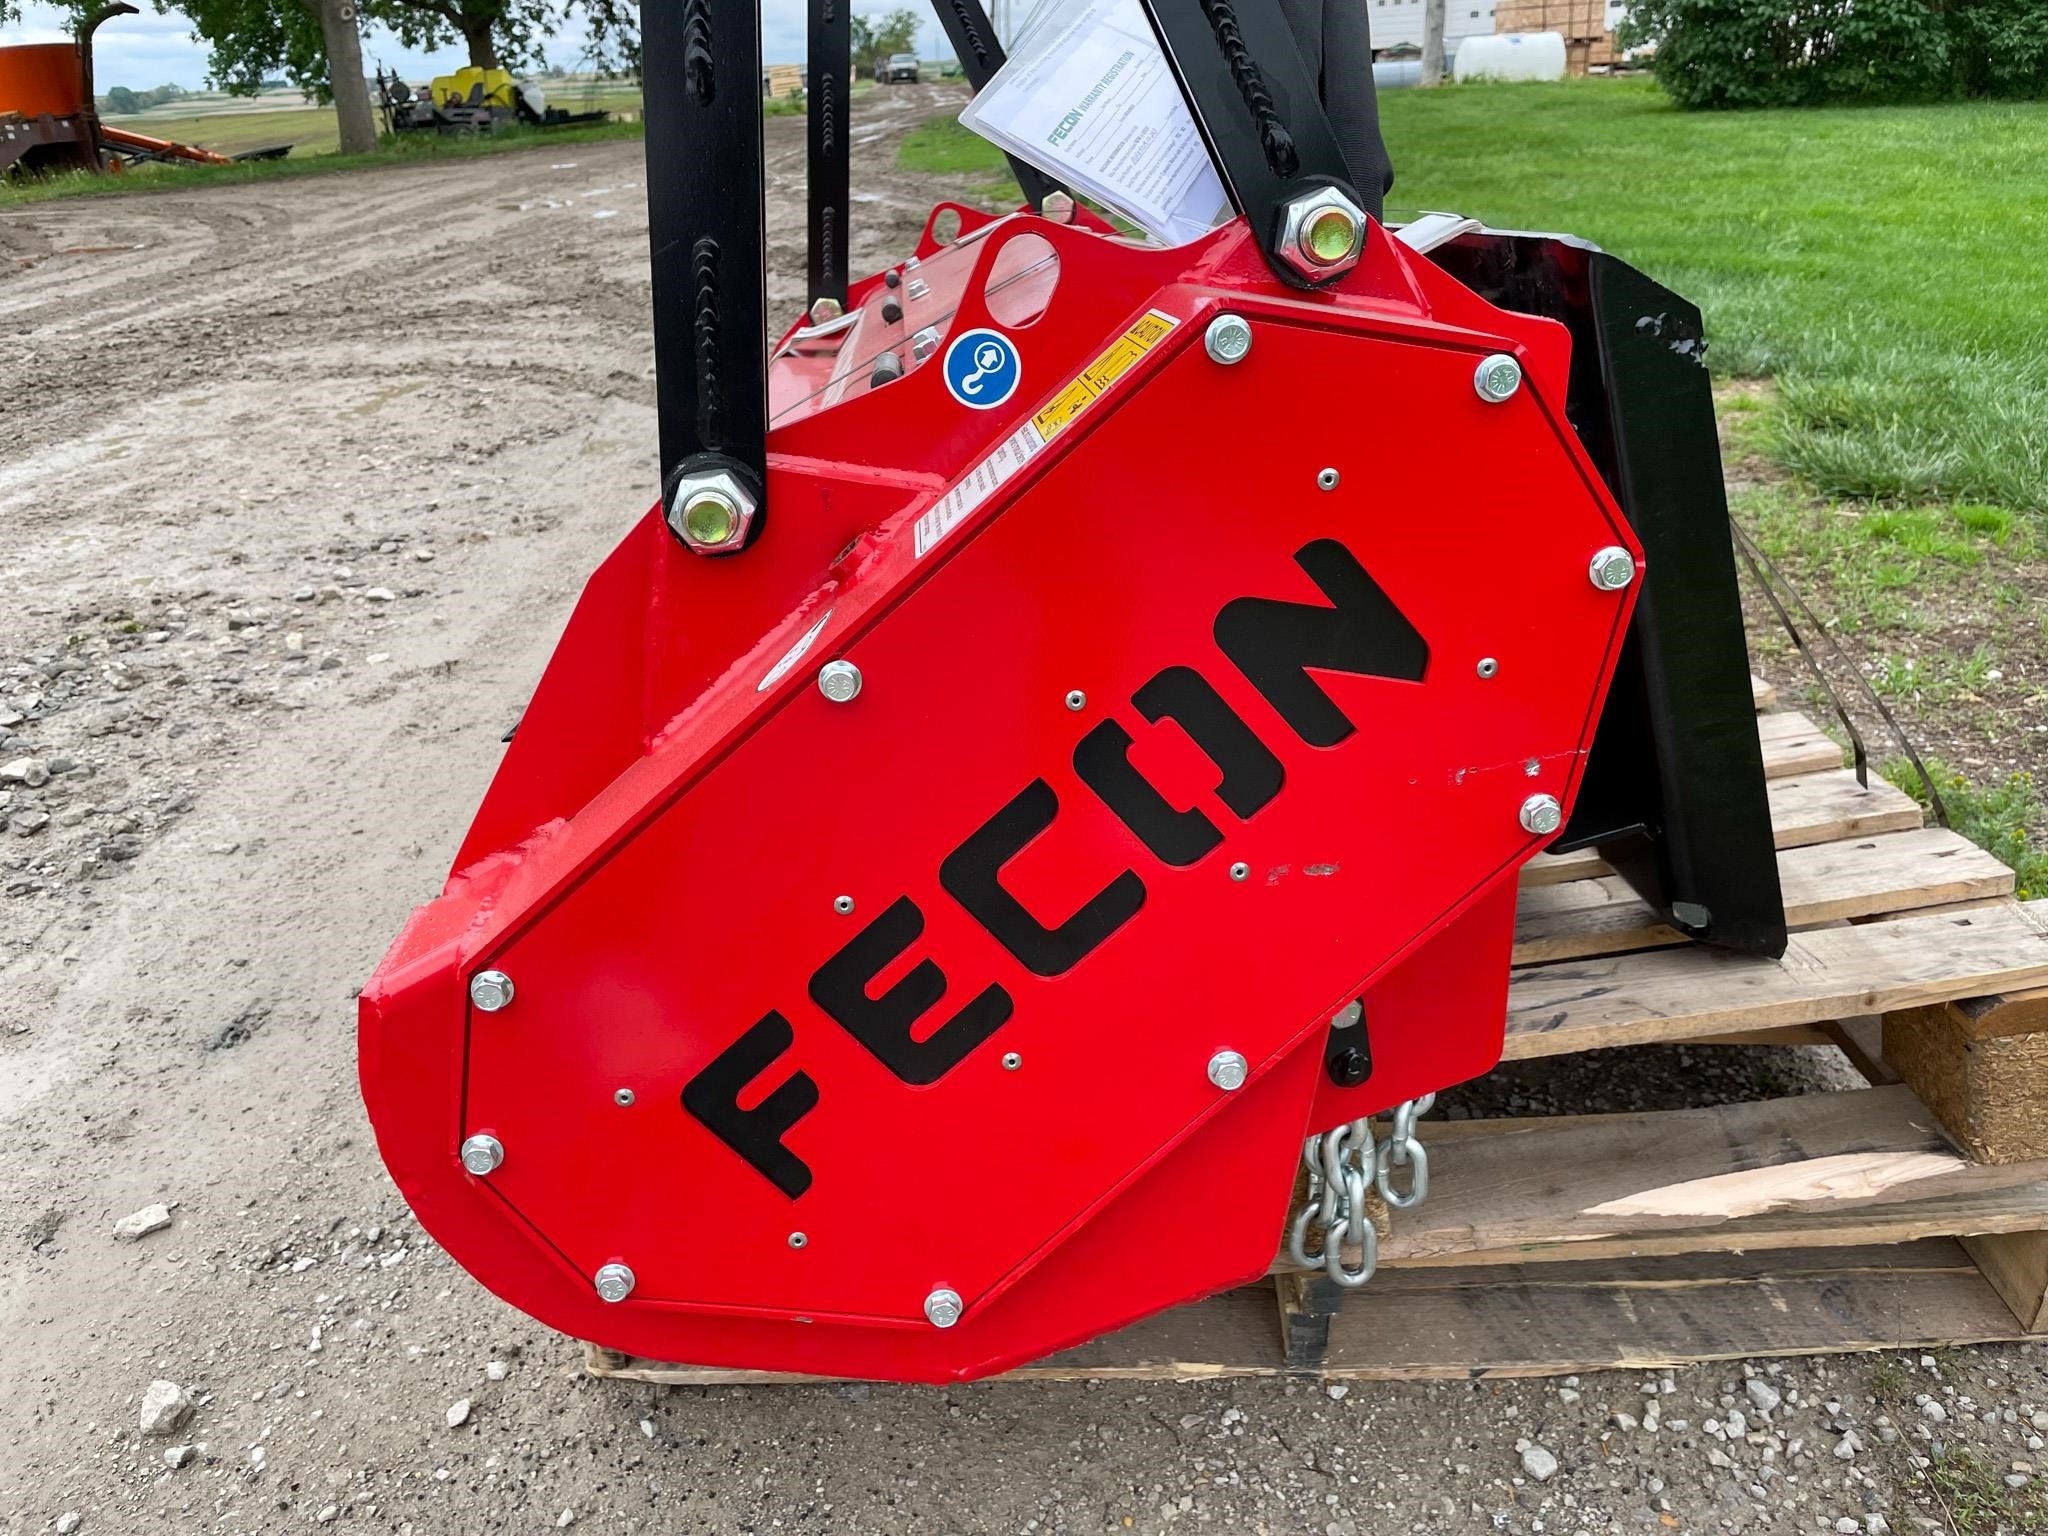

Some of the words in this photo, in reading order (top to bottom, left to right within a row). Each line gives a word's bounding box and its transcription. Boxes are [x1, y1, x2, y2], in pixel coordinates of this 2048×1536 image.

[1047, 107, 1084, 147] FECON
[1076, 82, 1107, 112] WARRANTY
[1100, 49, 1135, 86] REGISTRATION
[1132, 319, 1167, 345] CAUTION
[680, 537, 1430, 1201] FECON
